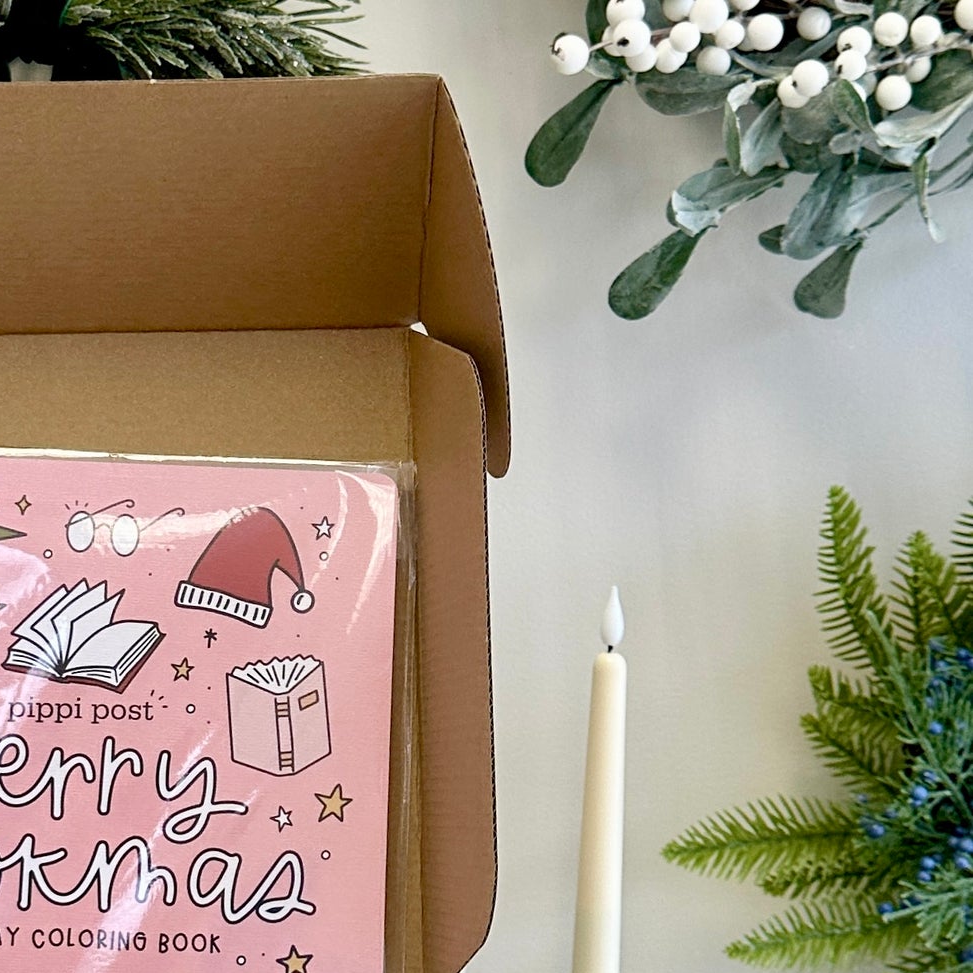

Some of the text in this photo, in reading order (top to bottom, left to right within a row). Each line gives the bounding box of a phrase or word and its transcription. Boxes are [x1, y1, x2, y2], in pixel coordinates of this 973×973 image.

[7, 697, 154, 724] pippi post
[32, 927, 147, 951] COLORING
[158, 933, 222, 954] BOOK
